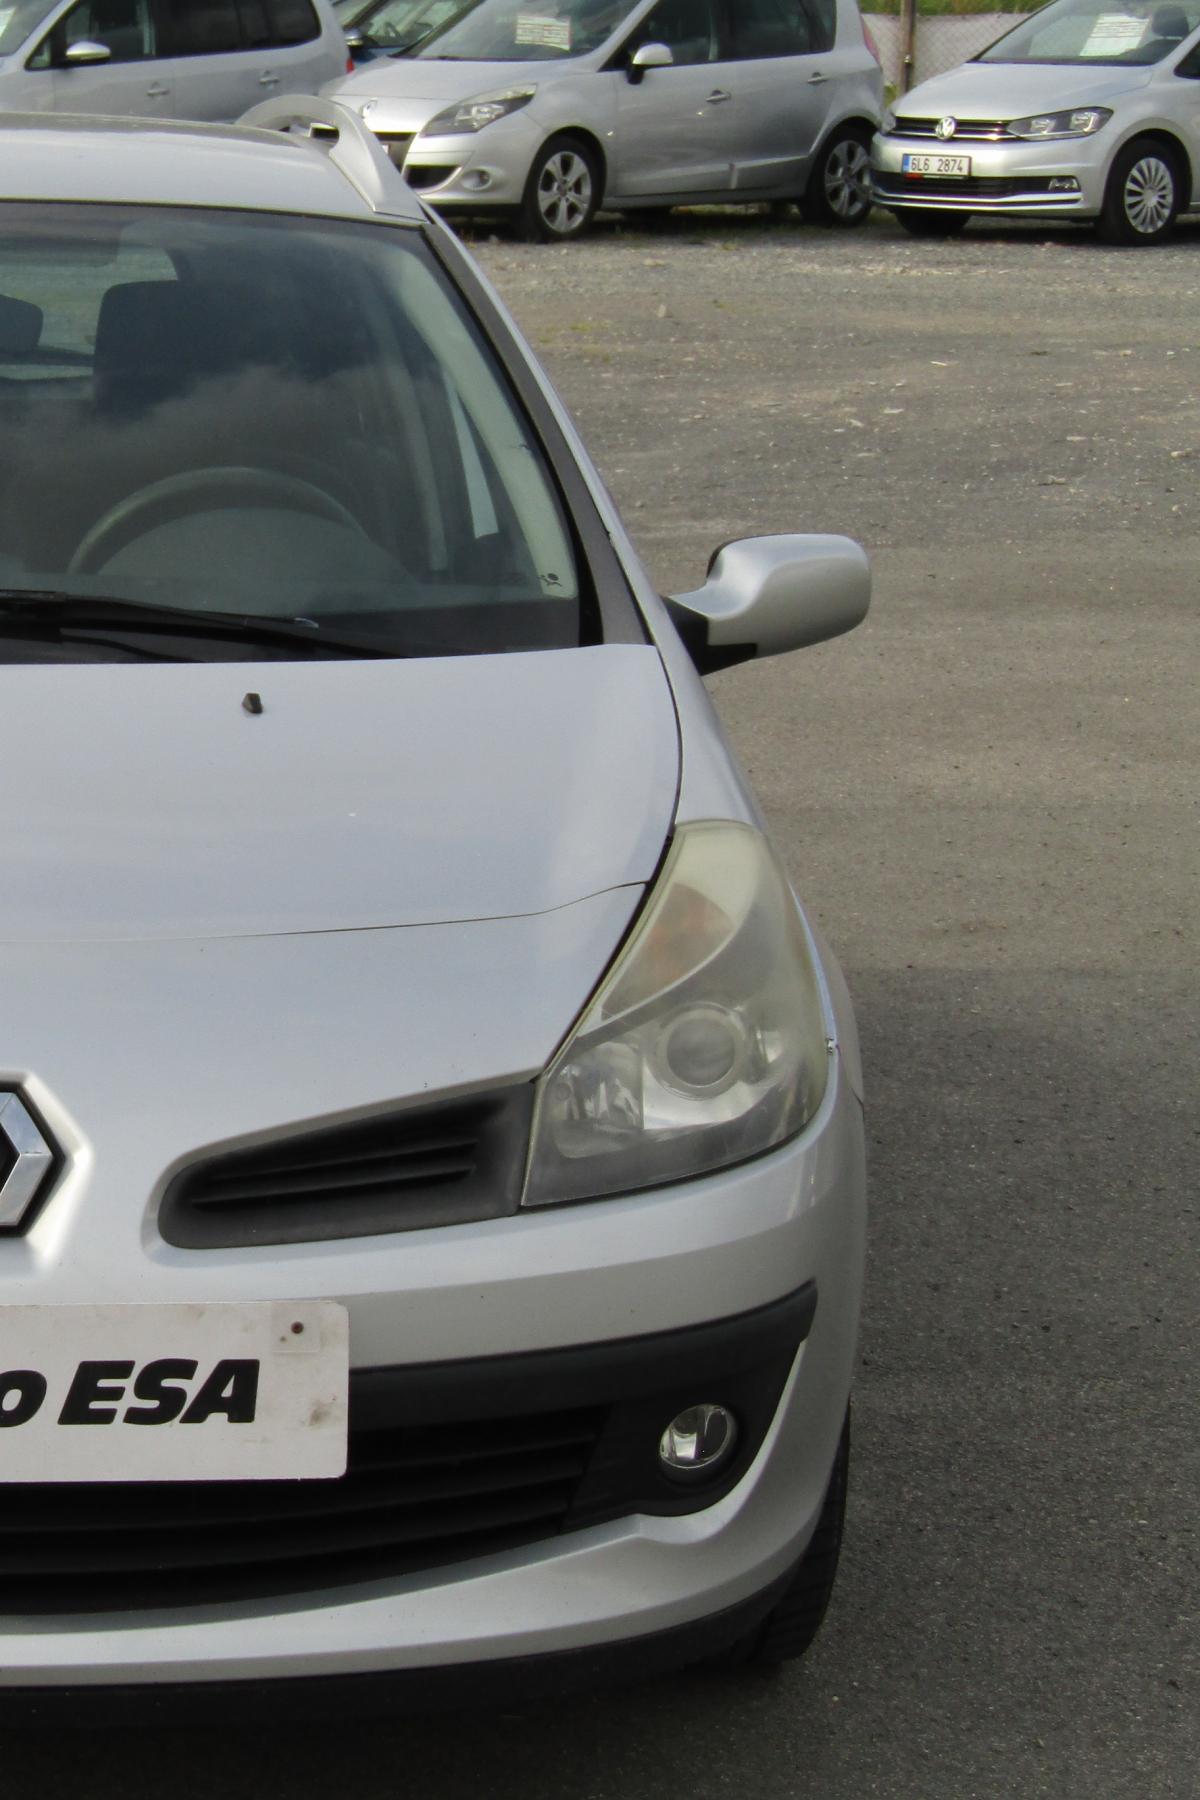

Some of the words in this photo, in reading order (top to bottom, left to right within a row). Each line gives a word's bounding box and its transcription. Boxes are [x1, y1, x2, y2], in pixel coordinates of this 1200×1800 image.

[911, 157, 930, 172] 6L6
[937, 158, 963, 172] 2874
[57, 1358, 261, 1425] ESA
